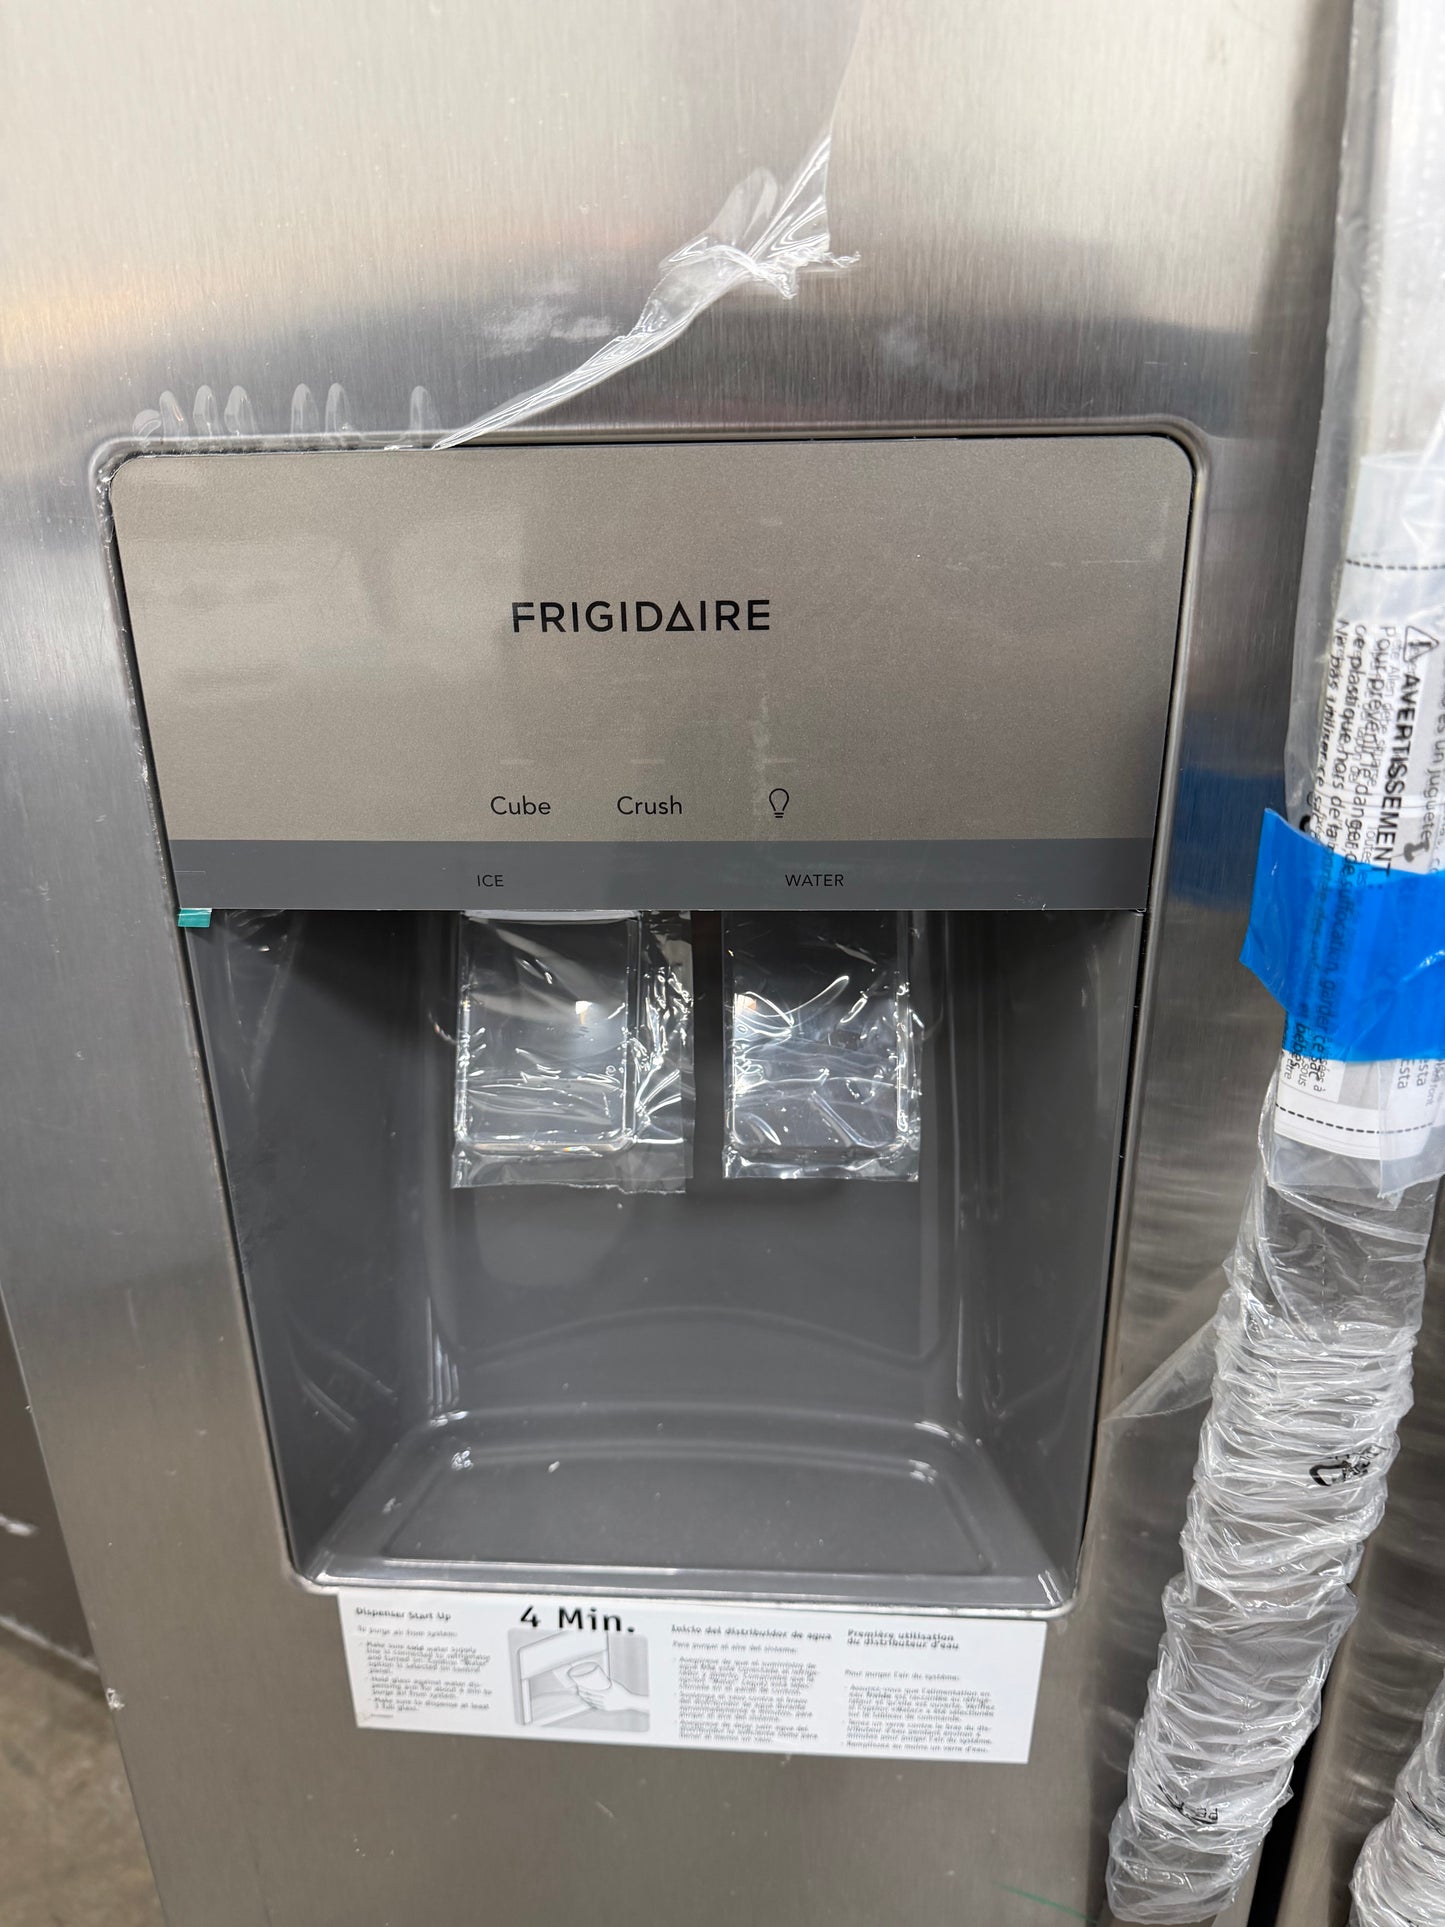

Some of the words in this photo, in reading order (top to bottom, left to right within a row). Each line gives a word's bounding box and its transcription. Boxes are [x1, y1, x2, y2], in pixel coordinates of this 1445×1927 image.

[512, 599, 770, 633] FRIGIDAIRE
[1374, 673, 1420, 877] AVERTISSEMENT
[490, 795, 552, 815] Cube
[617, 795, 683, 815] Crush
[477, 874, 504, 887] ICE
[785, 874, 844, 887] WATER
[520, 1605, 541, 1629] 4
[558, 1606, 635, 1633] Min.
